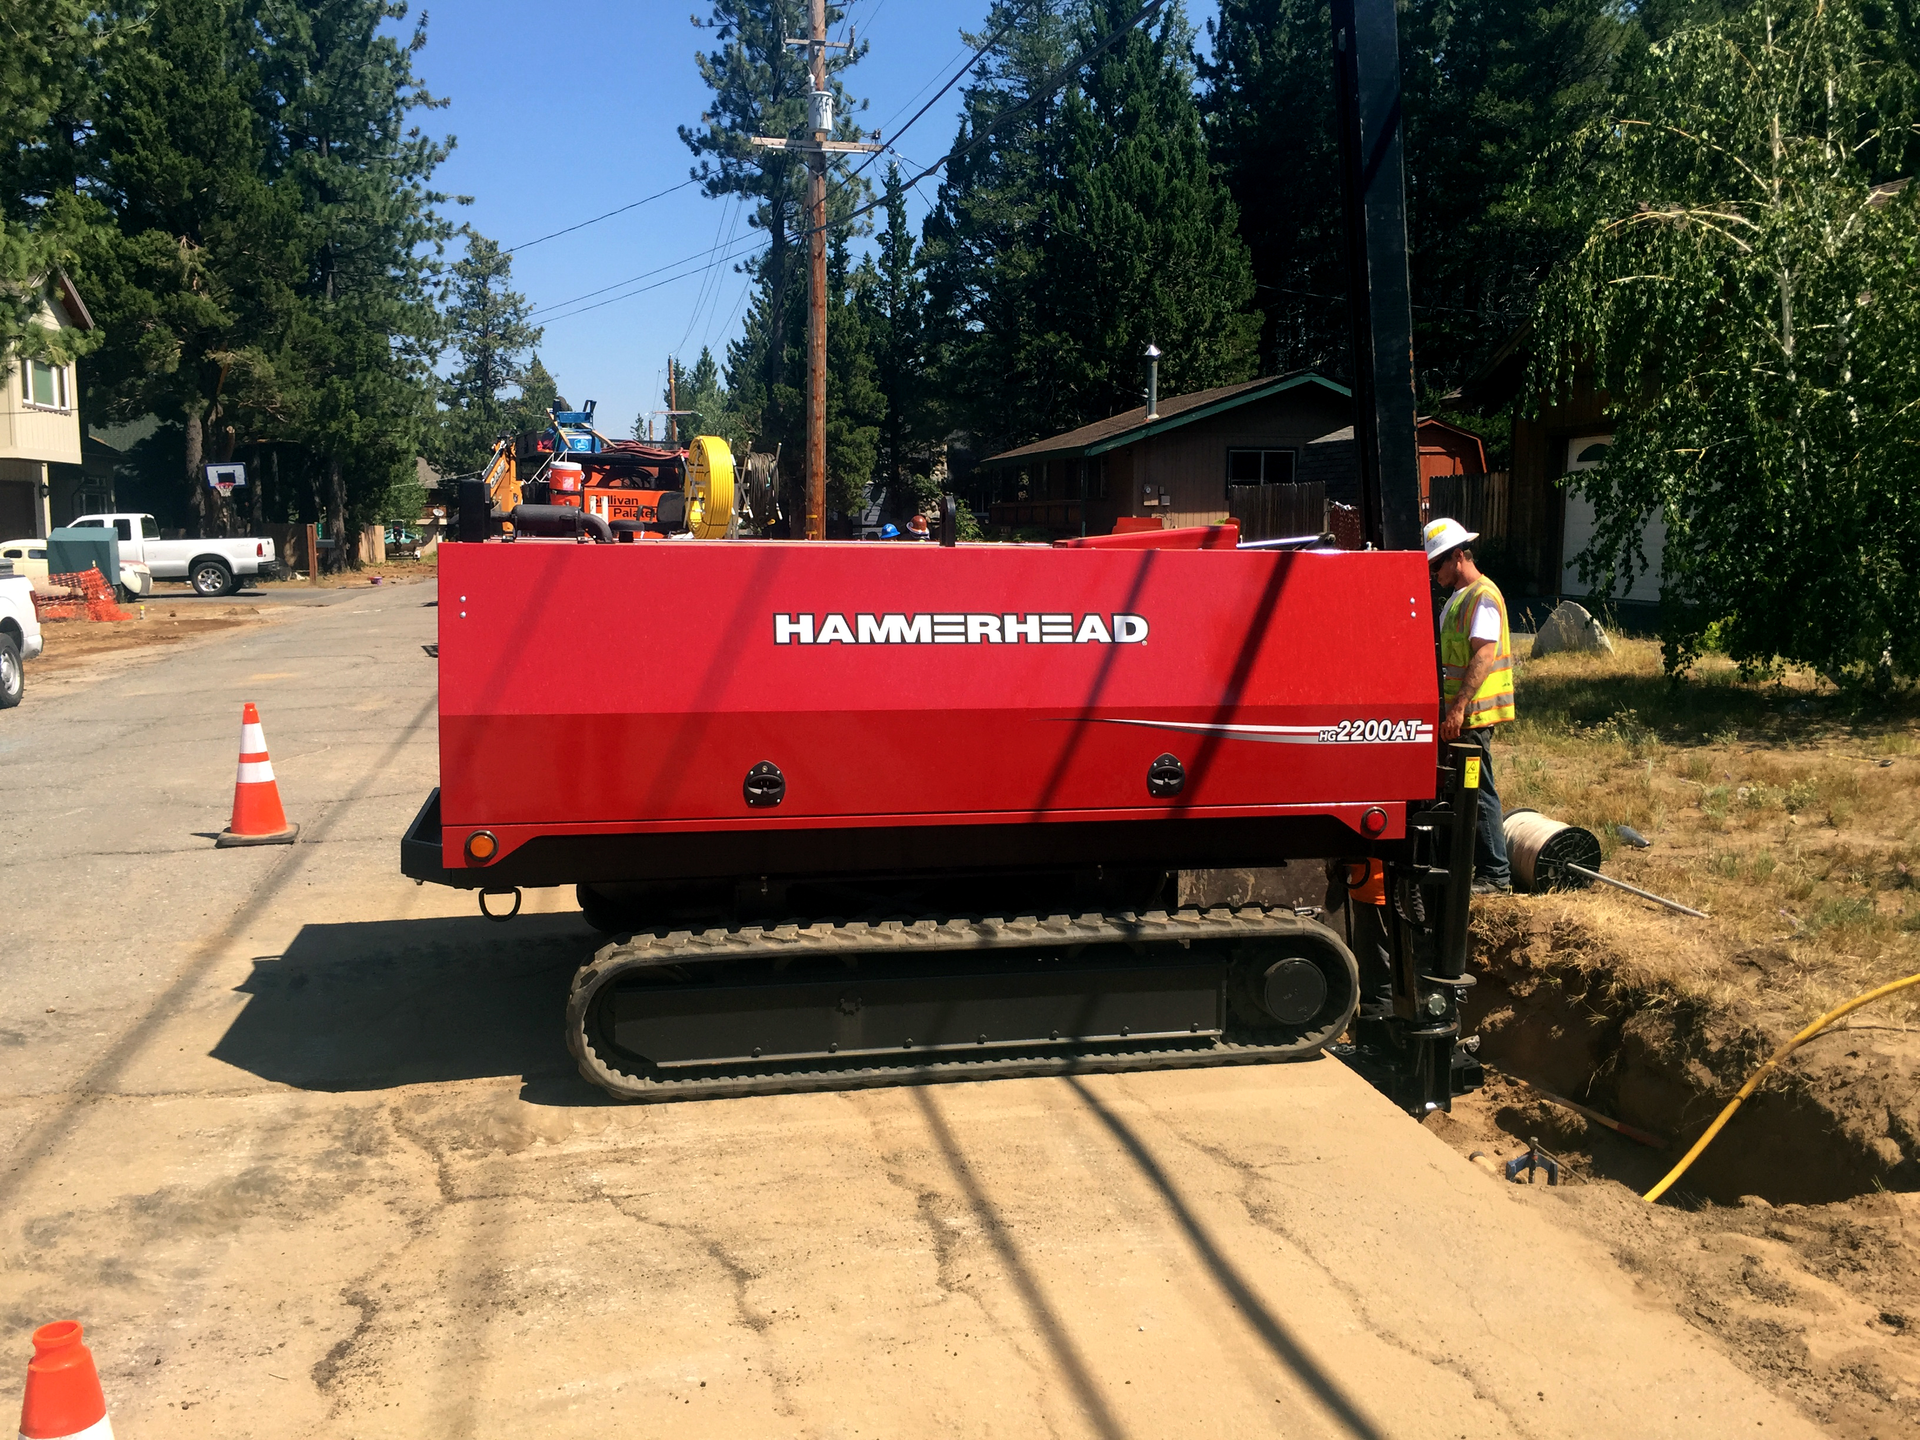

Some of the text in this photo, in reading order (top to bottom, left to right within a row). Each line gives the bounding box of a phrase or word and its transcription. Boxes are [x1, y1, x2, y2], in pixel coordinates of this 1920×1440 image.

[591, 495, 639, 505] llivan
[774, 613, 1149, 645] HAMMERHEAD
[1318, 719, 1422, 742] HG2200AT
